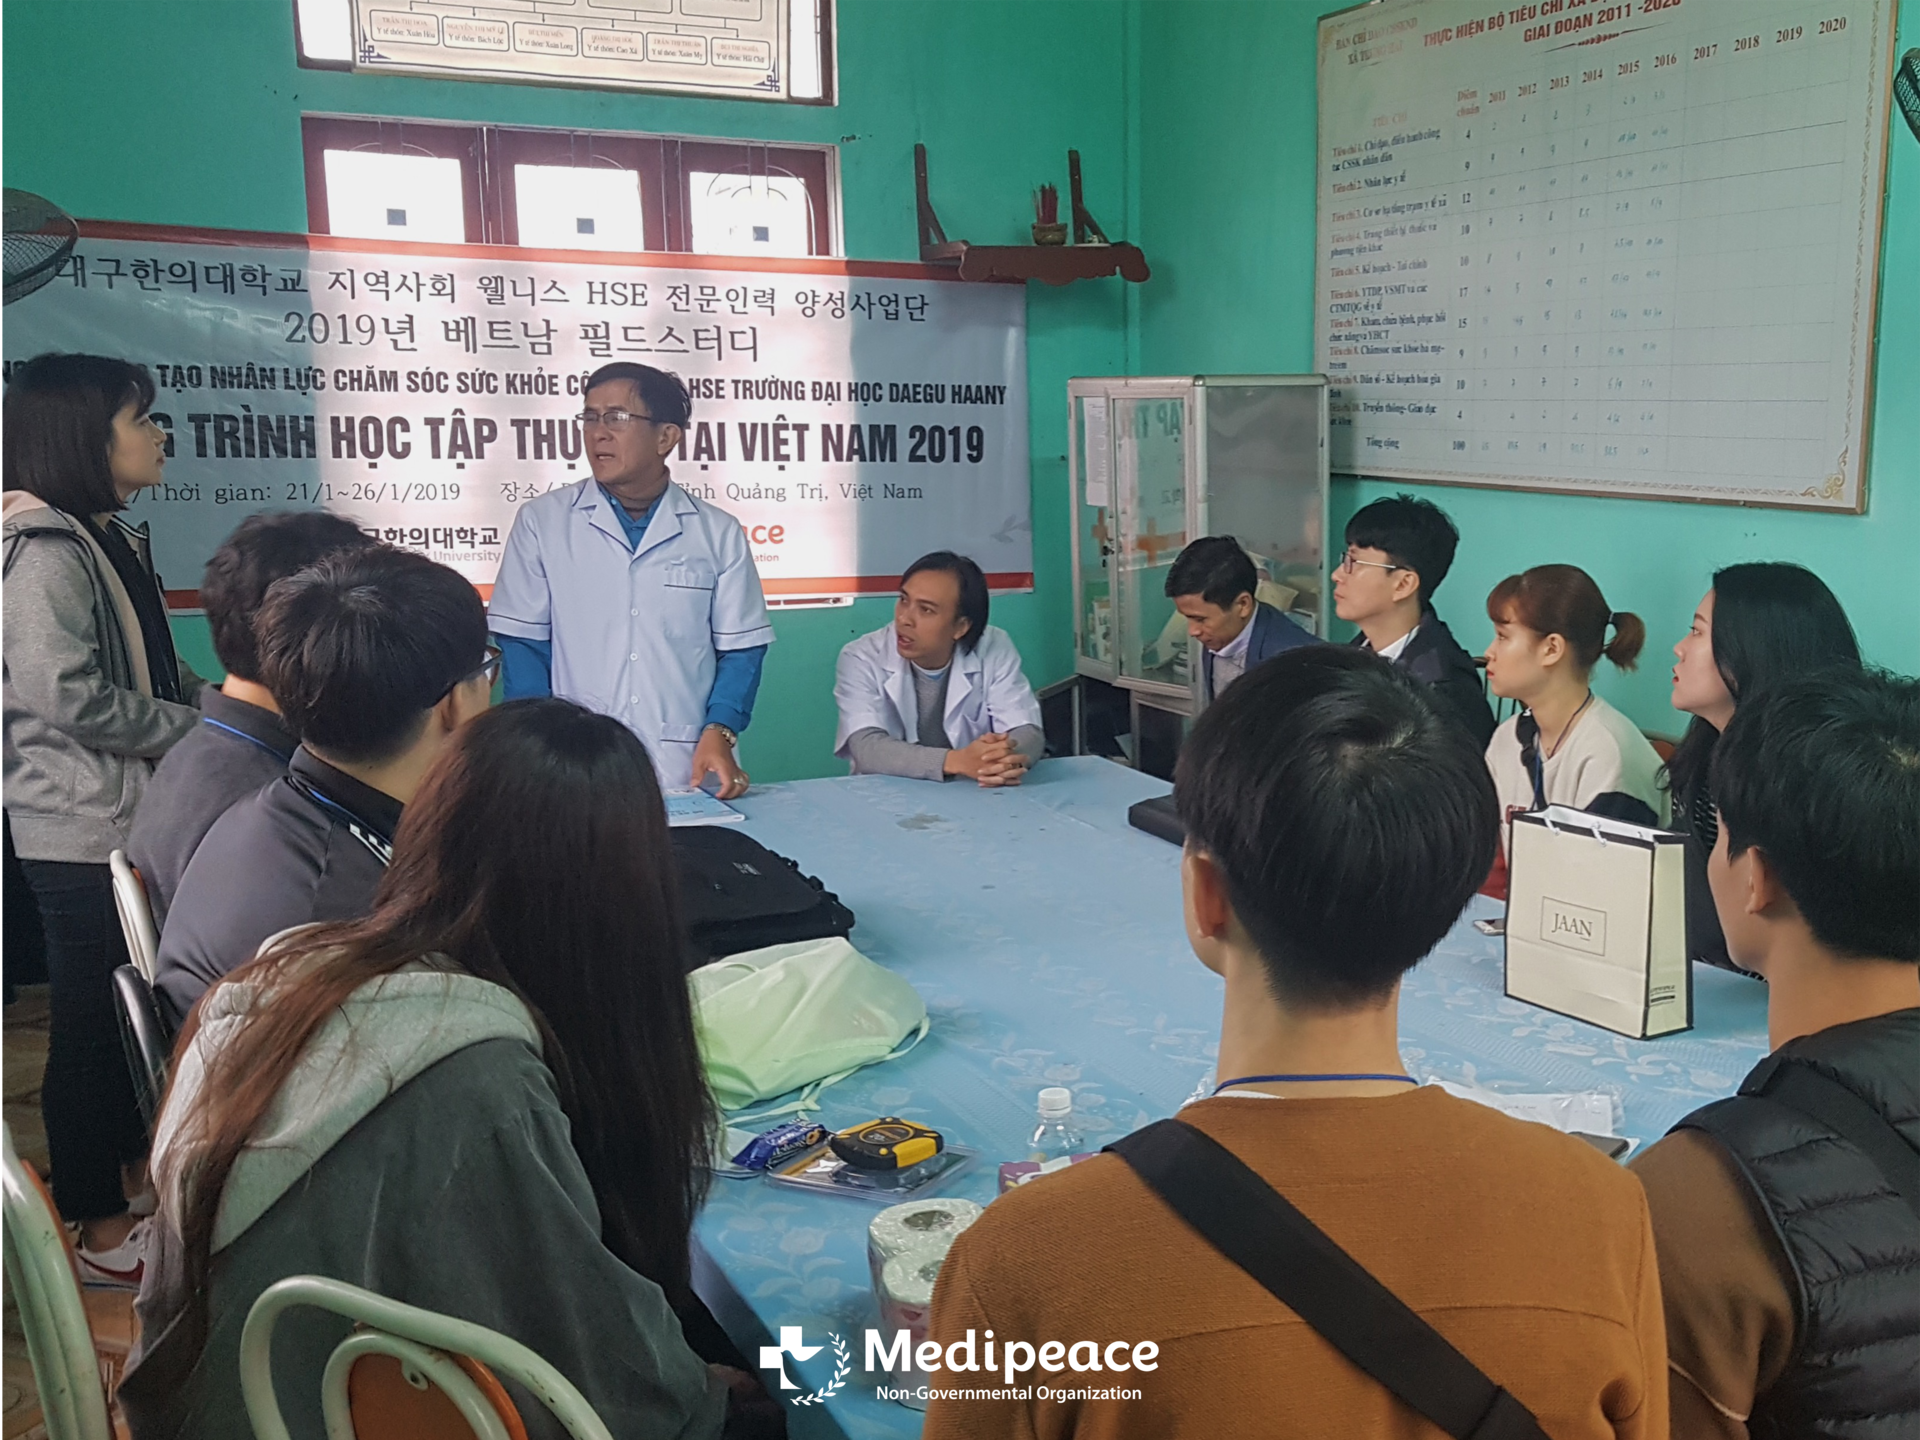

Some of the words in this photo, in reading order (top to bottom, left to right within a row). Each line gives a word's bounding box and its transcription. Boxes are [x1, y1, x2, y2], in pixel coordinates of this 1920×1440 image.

[1523, 24, 1550, 42] GIAI
[1554, 13, 1594, 33] ĐOẠN
[1597, 4, 1631, 24] 2011
[1488, 90, 1507, 105] 2011
[1517, 82, 1538, 98] 2012
[1549, 75, 1570, 91] 2013
[1581, 68, 1603, 85] 2014
[1617, 60, 1641, 77] 2015
[1653, 52, 1678, 69] 2016
[1693, 44, 1719, 60] 2017
[1734, 35, 1761, 53] 2018
[1775, 26, 1804, 44] 2019
[1817, 16, 1847, 35] 2020
[1461, 192, 1471, 204] 12
[1461, 223, 1471, 236] 10
[1459, 255, 1470, 267] 10
[57, 254, 308, 296] 대구한의대학교
[328, 267, 457, 304] 지역사회
[476, 274, 570, 306] 웰니스
[586, 280, 648, 307] HSE
[665, 283, 776, 317] 전문인력
[795, 289, 930, 322] 양성사업단
[1458, 286, 1469, 298] 17
[1457, 318, 1468, 328] 15
[284, 311, 418, 352] 2019년
[441, 314, 558, 356] 베트남
[579, 320, 758, 363] 필드스터디
[1458, 348, 1465, 359] 9
[156, 364, 202, 394] TẠO
[209, 362, 277, 391] NHÂN
[283, 364, 327, 396] LỰC
[333, 364, 399, 393] CHĂM
[406, 366, 449, 394] SÓC
[456, 367, 499, 395] SỨC
[505, 366, 560, 396] KHỎE
[688, 378, 726, 400] HSE
[731, 375, 807, 402] TRƯỜNG
[811, 380, 842, 406] ĐẠI
[848, 381, 883, 407] HỌC
[888, 382, 946, 404] DAEGU
[951, 385, 1007, 406] HAANY
[1456, 379, 1466, 391] 10
[187, 403, 318, 460] TRÌNH
[329, 415, 412, 470] HỌC
[423, 407, 499, 470] TẬP
[677, 421, 727, 471] TẠI
[738, 414, 810, 471] VIỆT
[821, 423, 898, 464] NAM
[908, 424, 984, 464] 2019
[214, 484, 272, 505] gian:
[286, 483, 461, 504] 21/1~26/1/2019
[726, 482, 787, 503] Quảng
[796, 483, 829, 502] Trị,
[839, 483, 874, 502] Việt
[883, 483, 924, 500] Nam
[432, 550, 501, 564] University
[1551, 913, 1593, 937] JAAN
